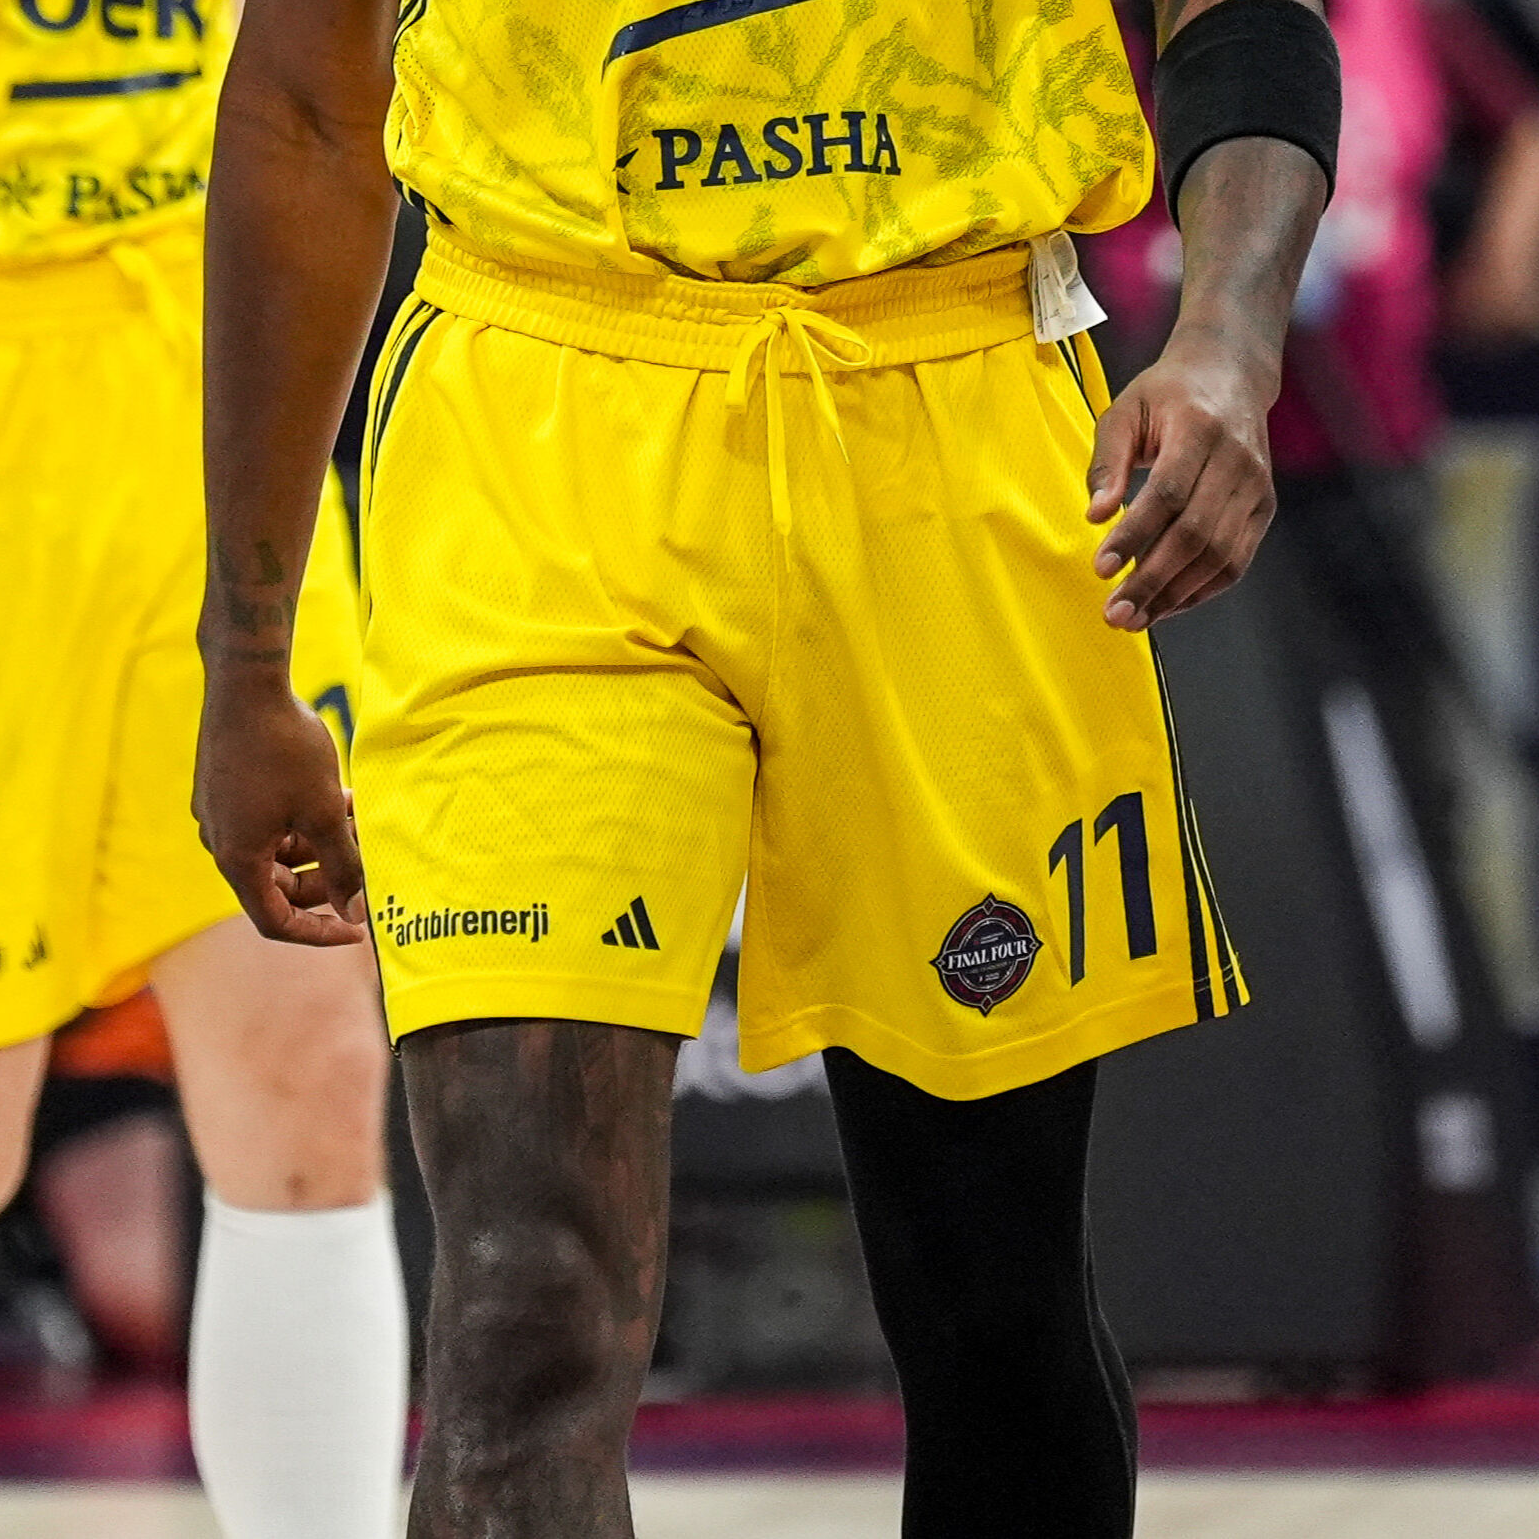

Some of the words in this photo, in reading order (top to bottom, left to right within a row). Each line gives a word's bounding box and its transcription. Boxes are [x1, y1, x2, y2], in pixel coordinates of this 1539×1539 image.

[650, 110, 903, 192] PASHA
[1048, 791, 1158, 988] 11
[947, 949, 990, 970] FINAL
[991, 939, 1028, 961] FOUR
